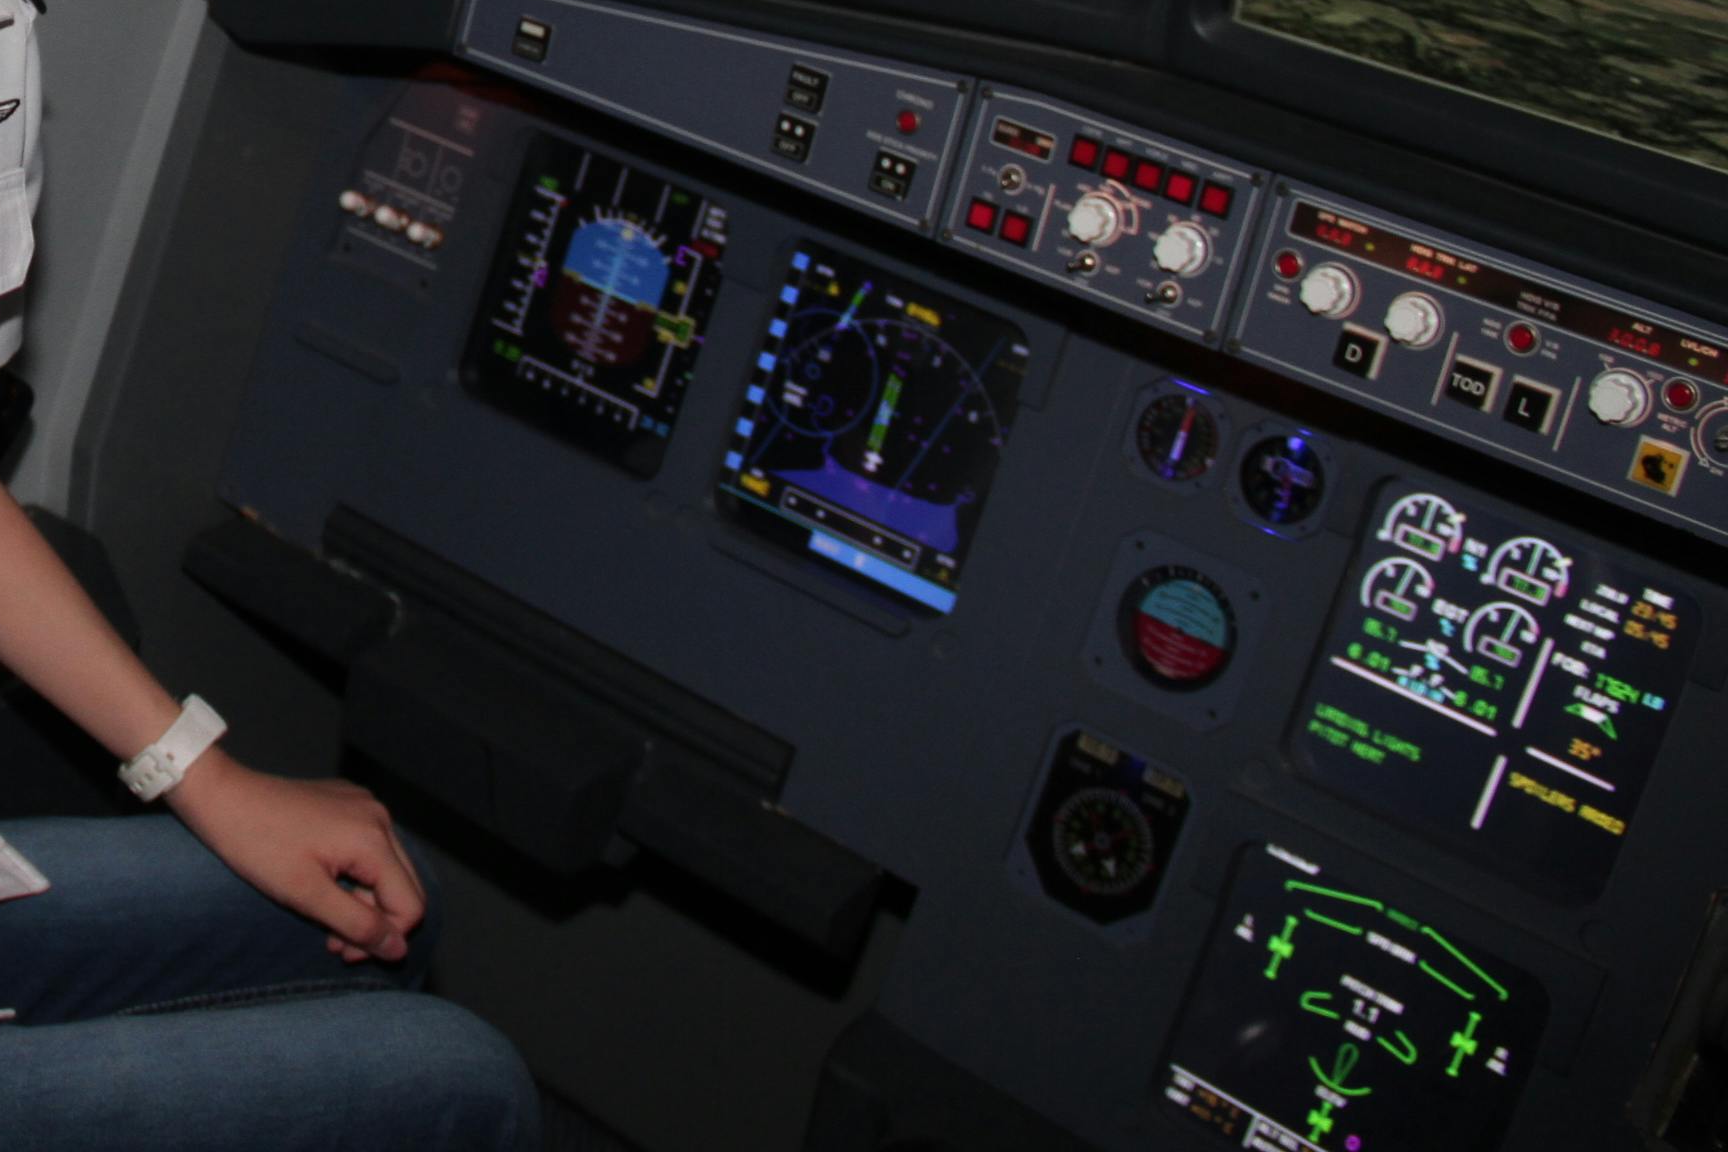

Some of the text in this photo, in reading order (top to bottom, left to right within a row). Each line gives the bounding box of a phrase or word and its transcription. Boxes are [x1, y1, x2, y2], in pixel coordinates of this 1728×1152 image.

[1344, 343, 1364, 364] D
[1451, 371, 1486, 399] TOD
[1518, 397, 1531, 418] L
